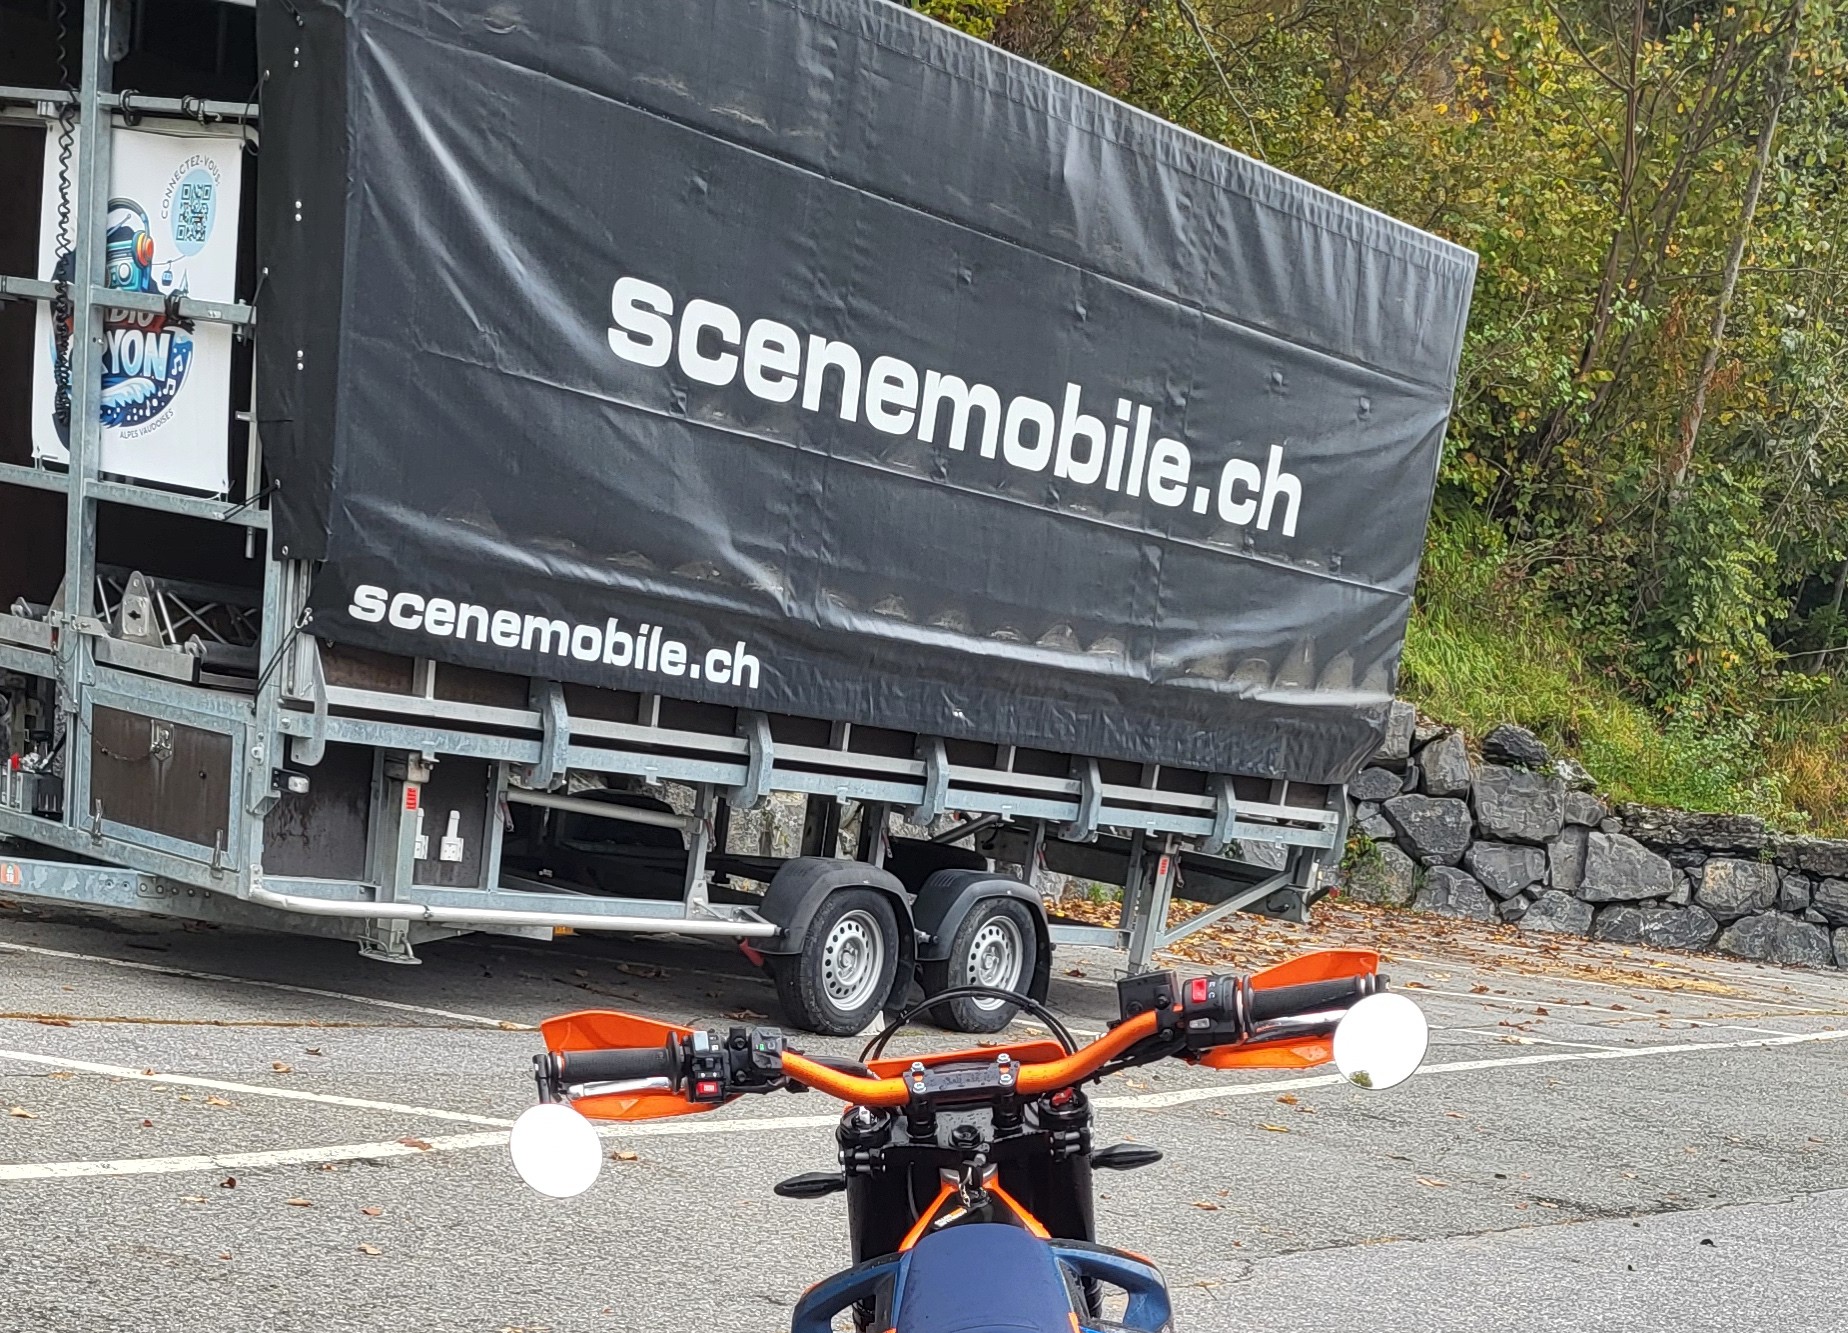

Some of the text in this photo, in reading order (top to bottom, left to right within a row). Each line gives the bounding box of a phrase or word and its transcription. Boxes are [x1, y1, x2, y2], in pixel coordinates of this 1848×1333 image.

[119, 408, 175, 440] ALPES VAUDOISES
[607, 275, 1302, 538] scenemobile.ch
[348, 584, 760, 690] scenemobile.ch
